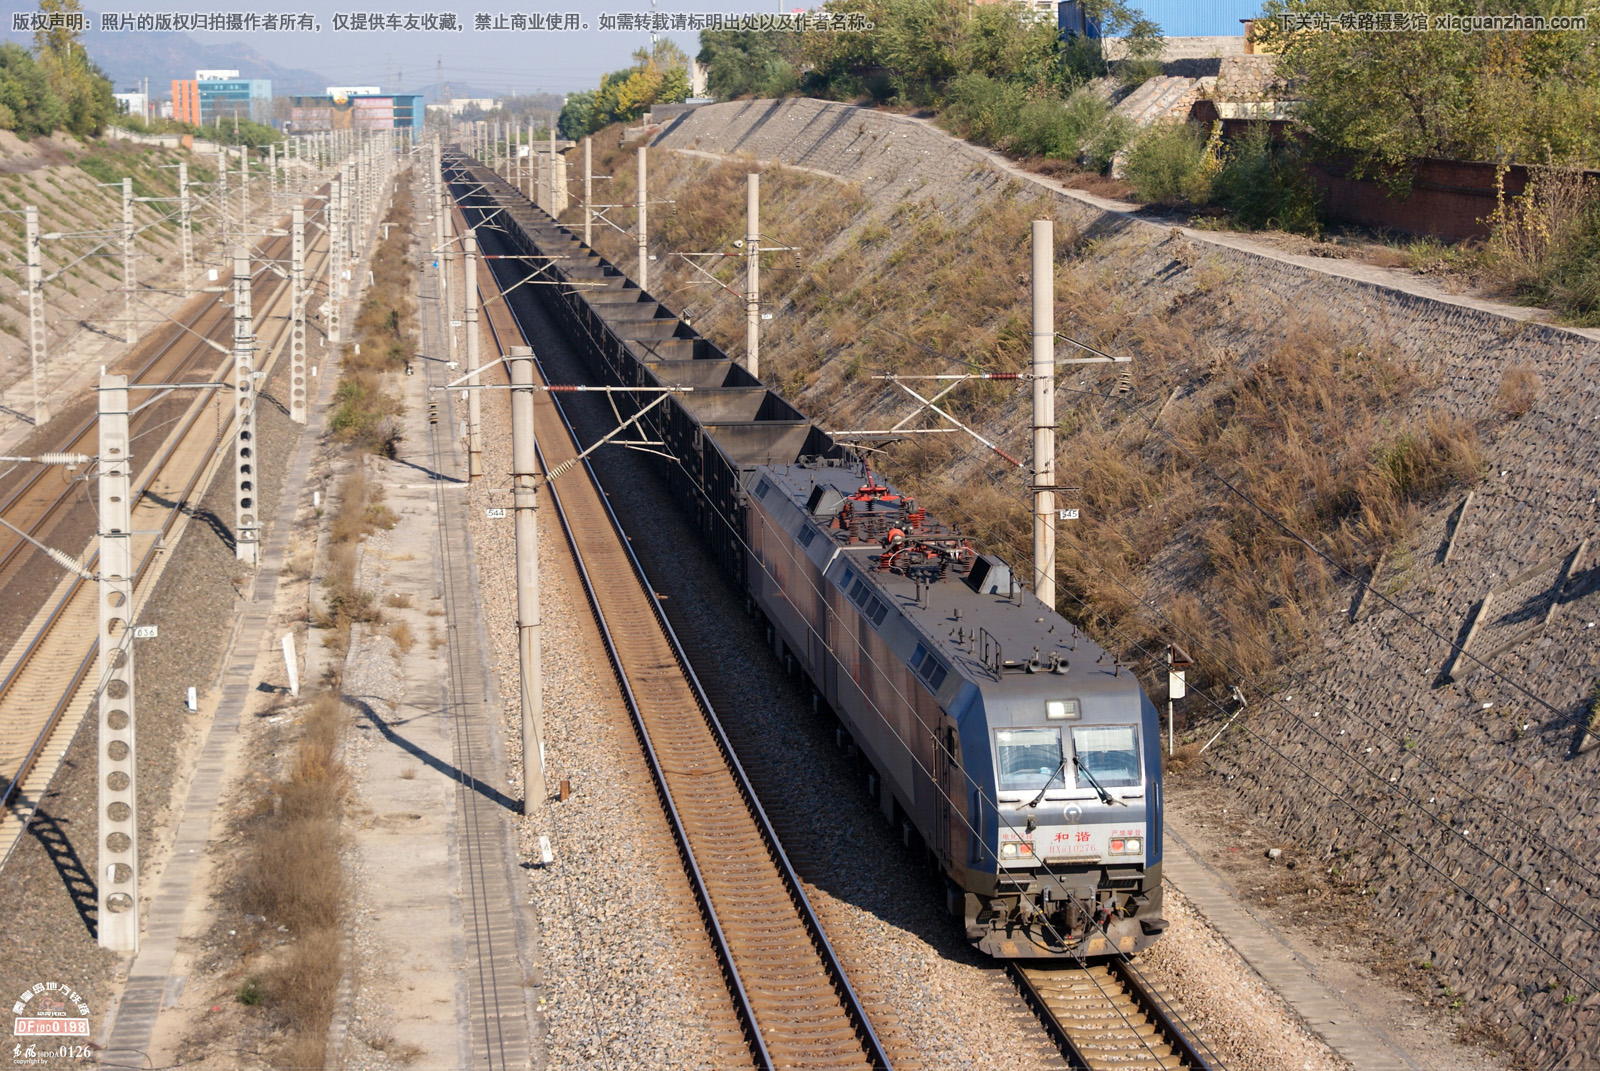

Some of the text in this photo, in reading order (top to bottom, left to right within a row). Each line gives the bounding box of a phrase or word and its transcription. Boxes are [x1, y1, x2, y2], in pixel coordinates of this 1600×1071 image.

[488, 509, 504, 517] 544
[137, 629, 155, 637] 036
[1053, 831, 1091, 843] 和谐
